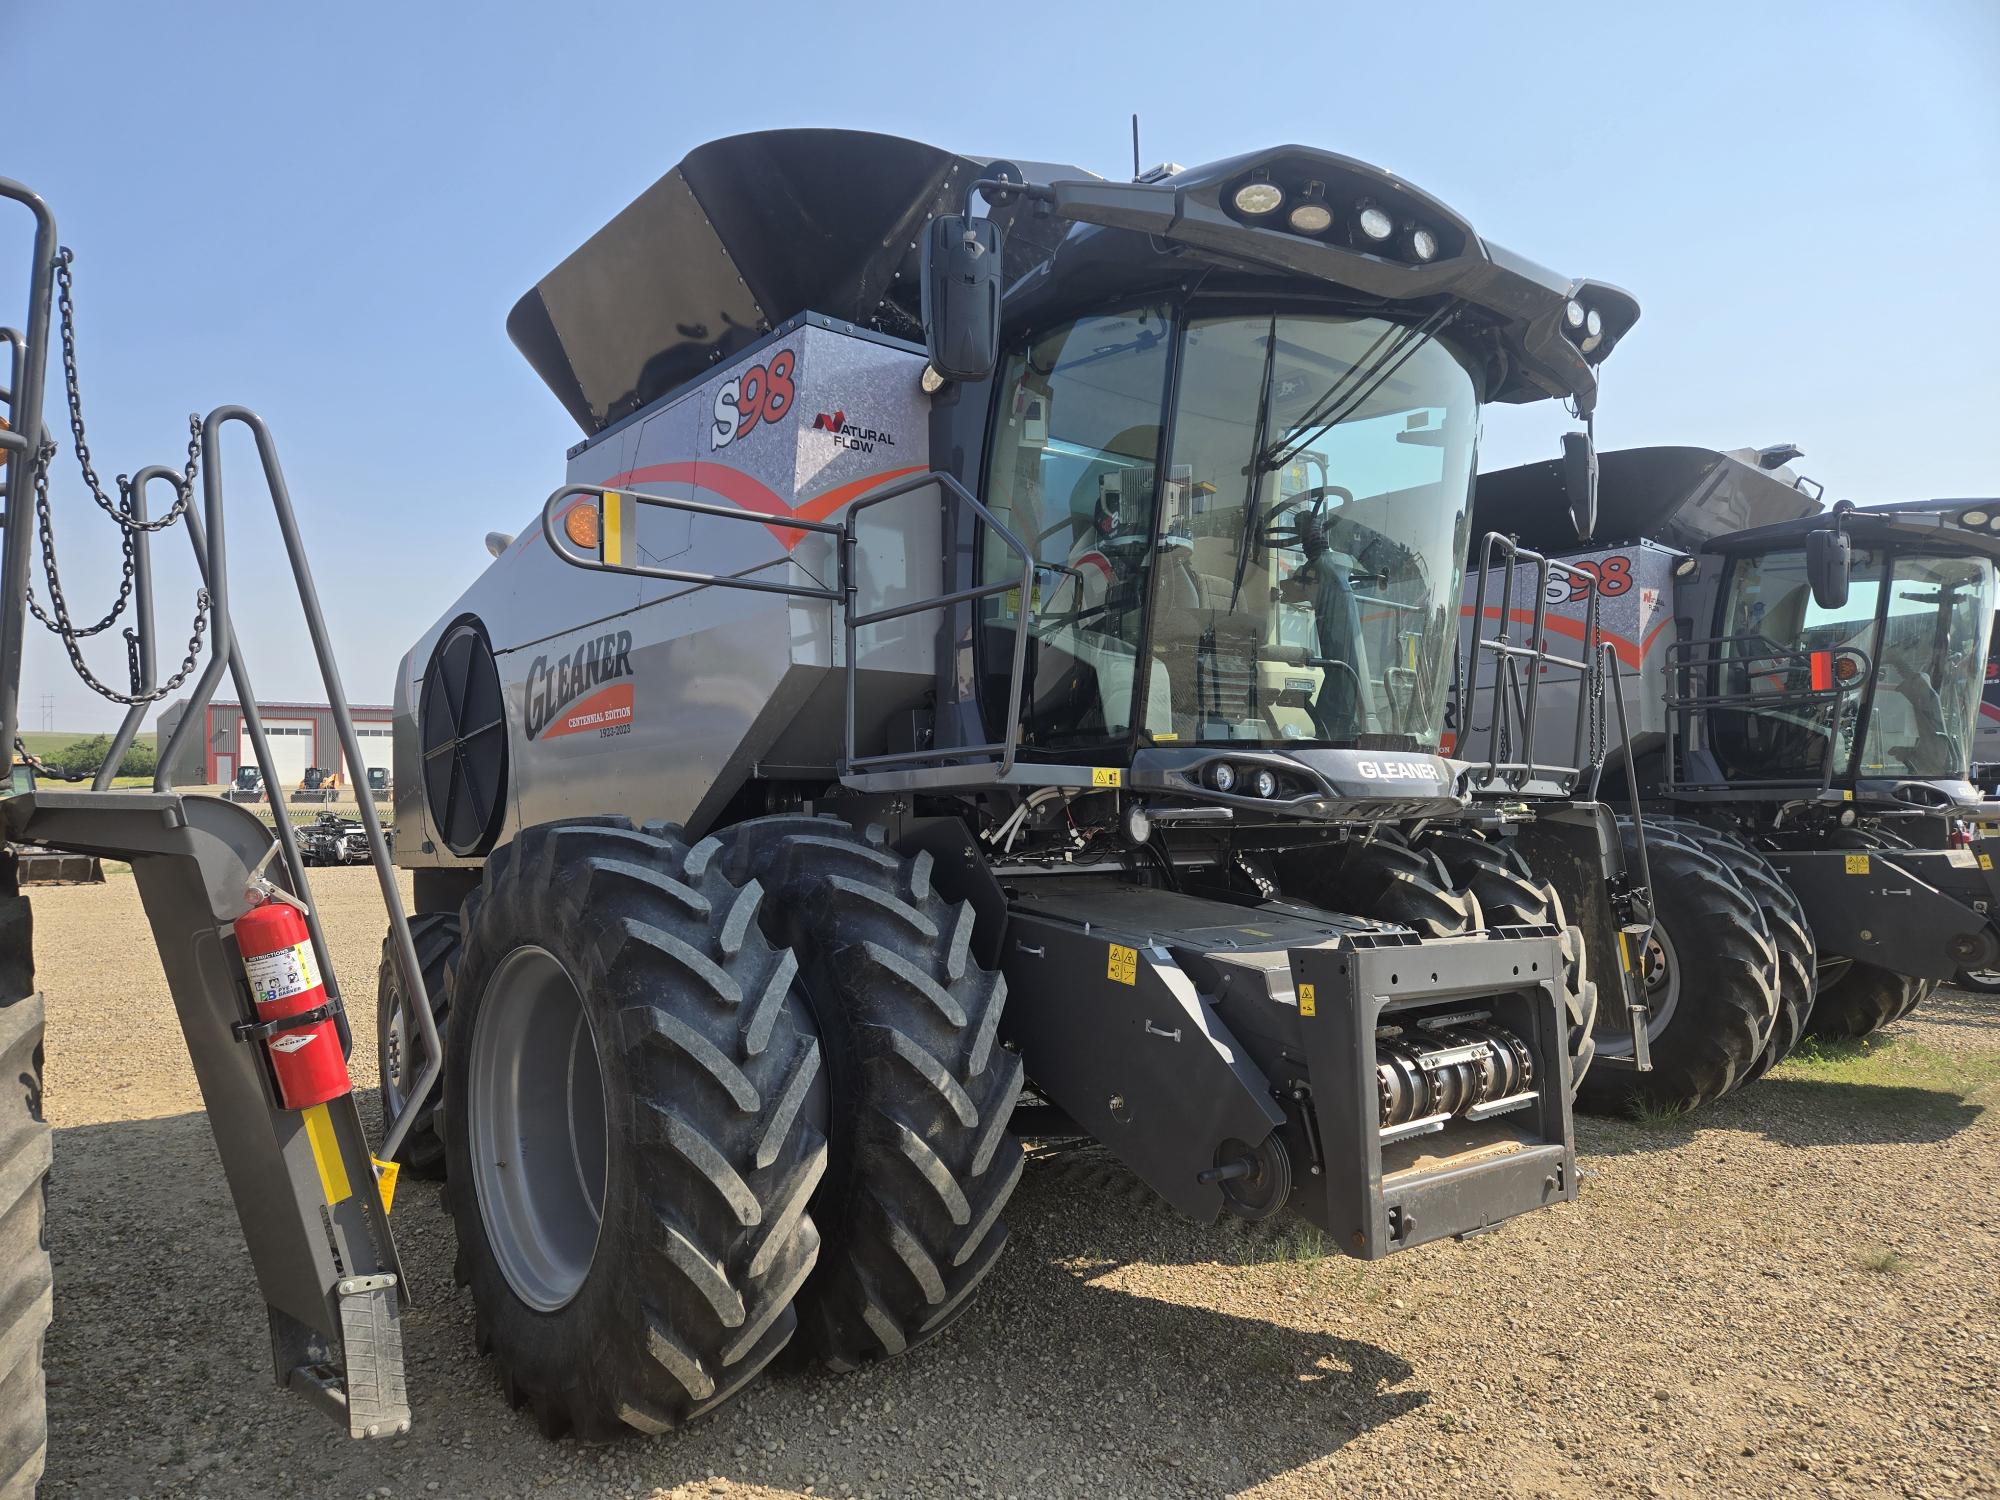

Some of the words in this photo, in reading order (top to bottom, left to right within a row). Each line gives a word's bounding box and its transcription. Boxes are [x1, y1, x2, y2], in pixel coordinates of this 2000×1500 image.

[711, 348, 795, 452] S98
[812, 410, 895, 445] NATURAL
[834, 435, 874, 453] FLOW
[525, 630, 634, 741] GLEANER
[568, 711, 604, 728] CENTENNIAL
[605, 706, 631, 721] EDITION
[600, 724, 631, 739] 1923-2023
[1357, 761, 1440, 780] GLEANER
